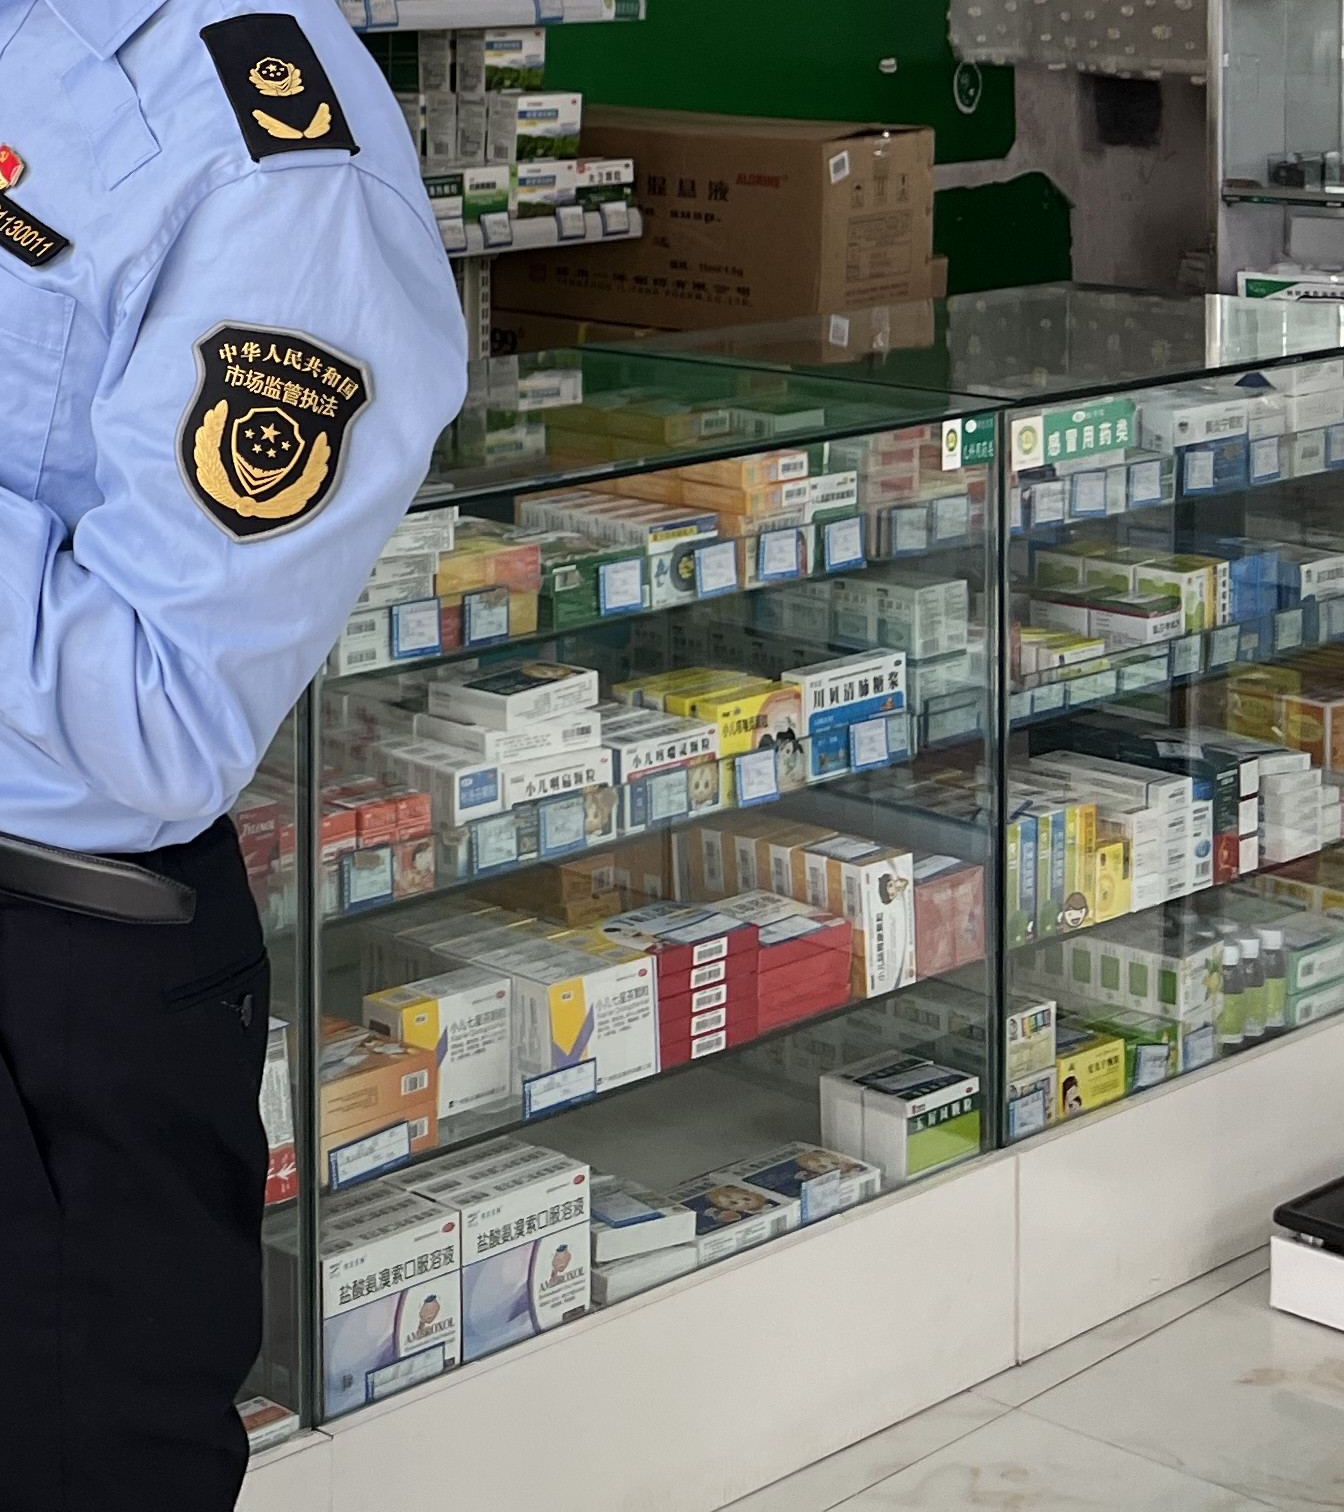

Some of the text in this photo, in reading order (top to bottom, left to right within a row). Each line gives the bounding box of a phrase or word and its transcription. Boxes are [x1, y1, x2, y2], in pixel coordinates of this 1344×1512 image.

[218, 340, 360, 400] 中华人民共和国
[223, 363, 341, 419] 市场监管执法
[1046, 417, 1129, 457] 感冒用药类
[477, 1196, 586, 1255] 盐酸氨溴索口服溶液
[338, 1244, 456, 1306] 盐酸氨溴索口服溶液
